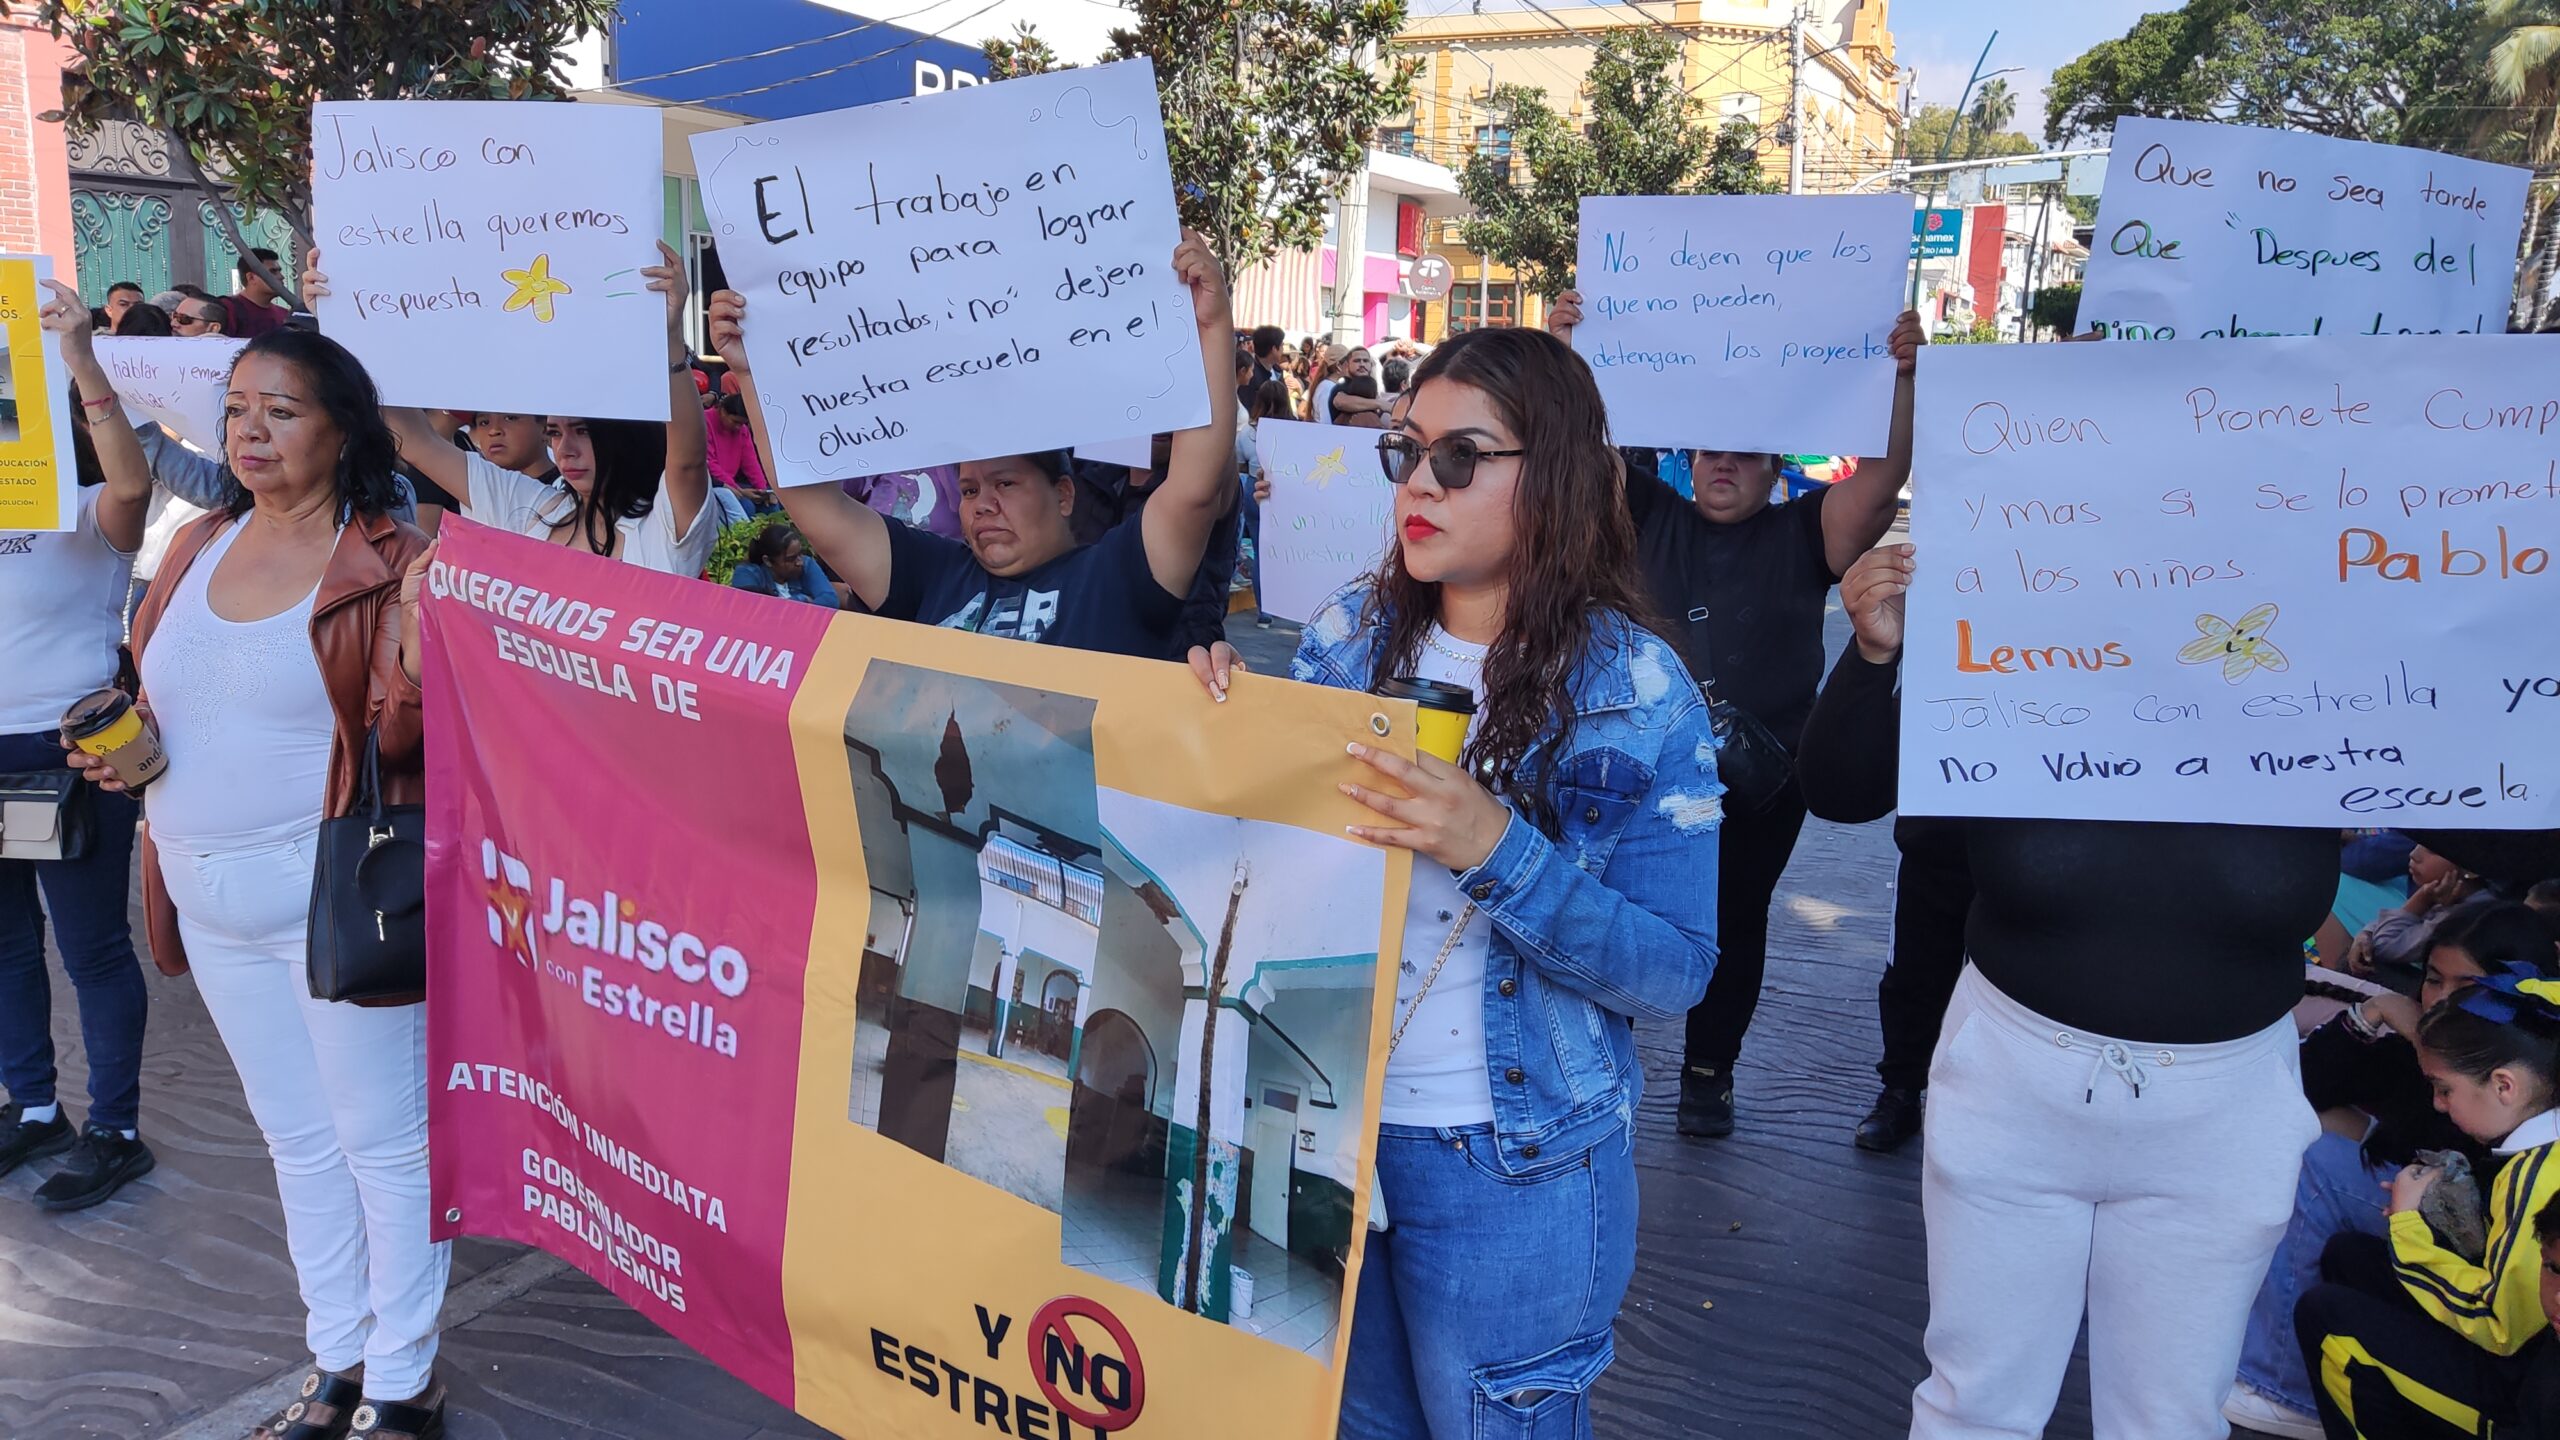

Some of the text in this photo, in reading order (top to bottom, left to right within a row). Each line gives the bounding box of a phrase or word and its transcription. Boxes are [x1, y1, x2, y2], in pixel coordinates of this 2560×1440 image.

[323, 114, 456, 180] Jalisco
[2134, 143, 2215, 188] Que
[2258, 169, 2297, 193] no
[2420, 171, 2487, 221] tarde
[338, 199, 629, 251] estrella queremos
[754, 162, 1076, 244] El trabajo en
[777, 200, 1134, 303] equipo para lograr
[1766, 247, 1812, 275] que
[1832, 230, 1871, 263] los
[2110, 220, 2185, 260] Que
[1056, 262, 1144, 301] dejen
[1597, 295, 1638, 320] que
[1648, 298, 1677, 313] no
[112, 352, 159, 380] hablar
[801, 301, 1159, 416] nuestra escuela en el
[1593, 340, 1696, 372] detengan
[1725, 330, 1760, 362] los
[1963, 402, 2112, 455] Quien
[2186, 383, 2373, 434] Promete
[2000, 500, 2101, 529] mas
[2338, 467, 2368, 509] lo
[1955, 567, 1983, 593] a
[2015, 549, 2079, 593] los
[2338, 525, 2549, 583] Pablo
[428, 560, 794, 689] QUEREMOS SER UNA
[1956, 619, 2133, 673] Lemus
[493, 625, 702, 721] ESCUELA DE
[1924, 691, 2091, 732] Jalisco
[2242, 660, 2437, 717] estrella
[1939, 756, 1998, 784] no
[2175, 756, 2209, 776] a
[2250, 737, 2404, 776] nuestra
[543, 877, 749, 997] Jalisco
[546, 959, 737, 1058] con Estrella
[447, 1062, 727, 1233] ATENCIÓN INMEDIATA
[522, 1148, 682, 1277] GOBERNADOR
[524, 1184, 686, 1313] PABLO LEMUS
[974, 1304, 1131, 1412] Y NO
